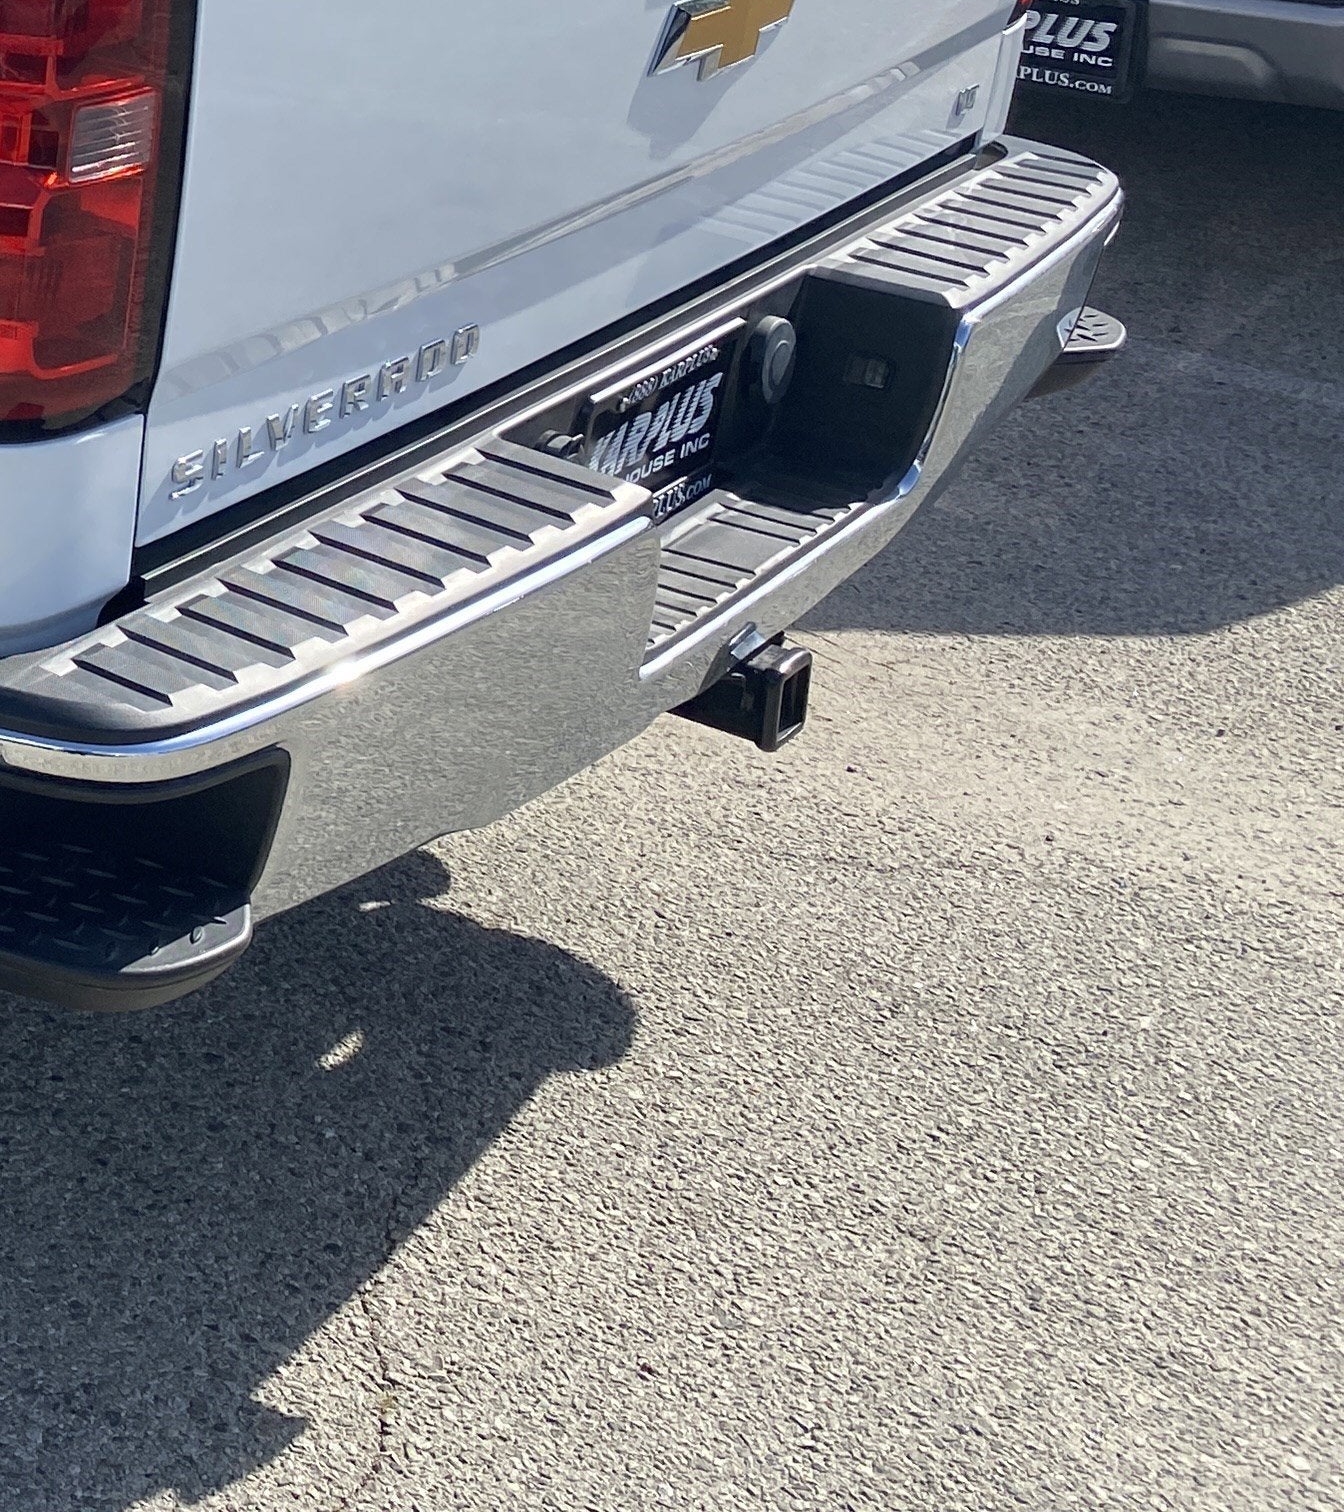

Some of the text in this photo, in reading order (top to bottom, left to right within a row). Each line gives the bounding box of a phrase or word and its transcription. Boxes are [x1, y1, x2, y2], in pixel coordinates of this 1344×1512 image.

[1024, 9, 1118, 52] PLUS
[1073, 52, 1114, 67] INC
[1016, 65, 1113, 95] PLUS.COM
[170, 322, 481, 500] SILVERADO
[679, 432, 712, 460] INC
